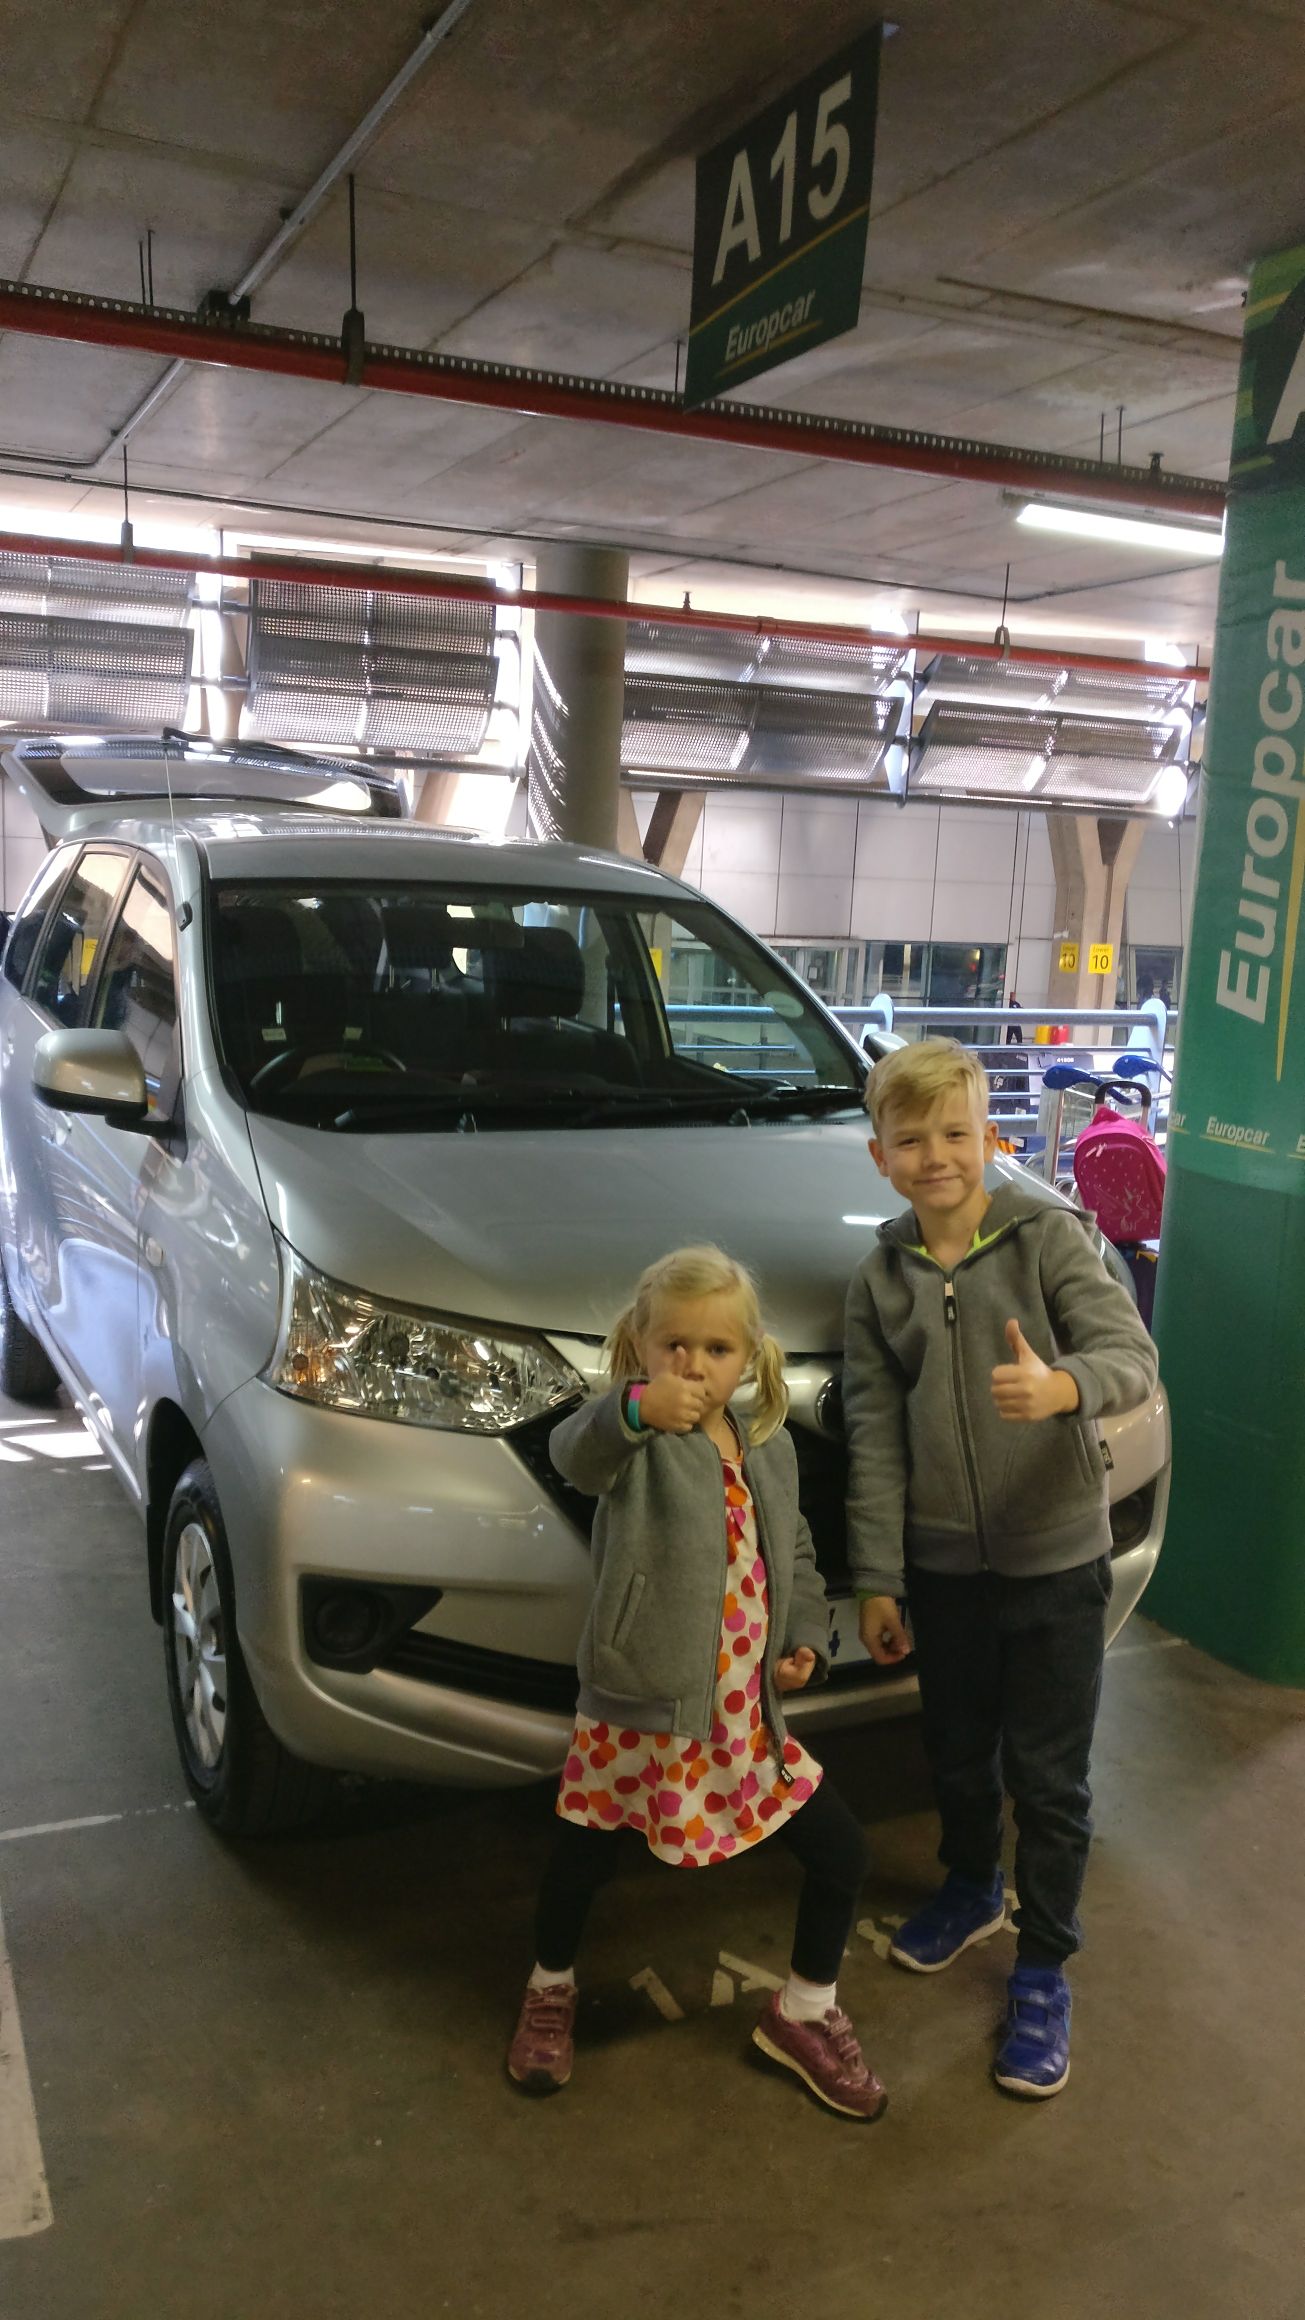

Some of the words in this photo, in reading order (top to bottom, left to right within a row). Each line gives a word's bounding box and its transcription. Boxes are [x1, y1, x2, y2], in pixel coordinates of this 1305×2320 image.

[711, 71, 852, 287] A15
[724, 289, 816, 362] Europcar
[1216, 560, 1305, 1024] Europcar
[1062, 953, 1076, 968] 10
[1092, 955, 1109, 970] 10
[1206, 1116, 1270, 1146] Europcar
